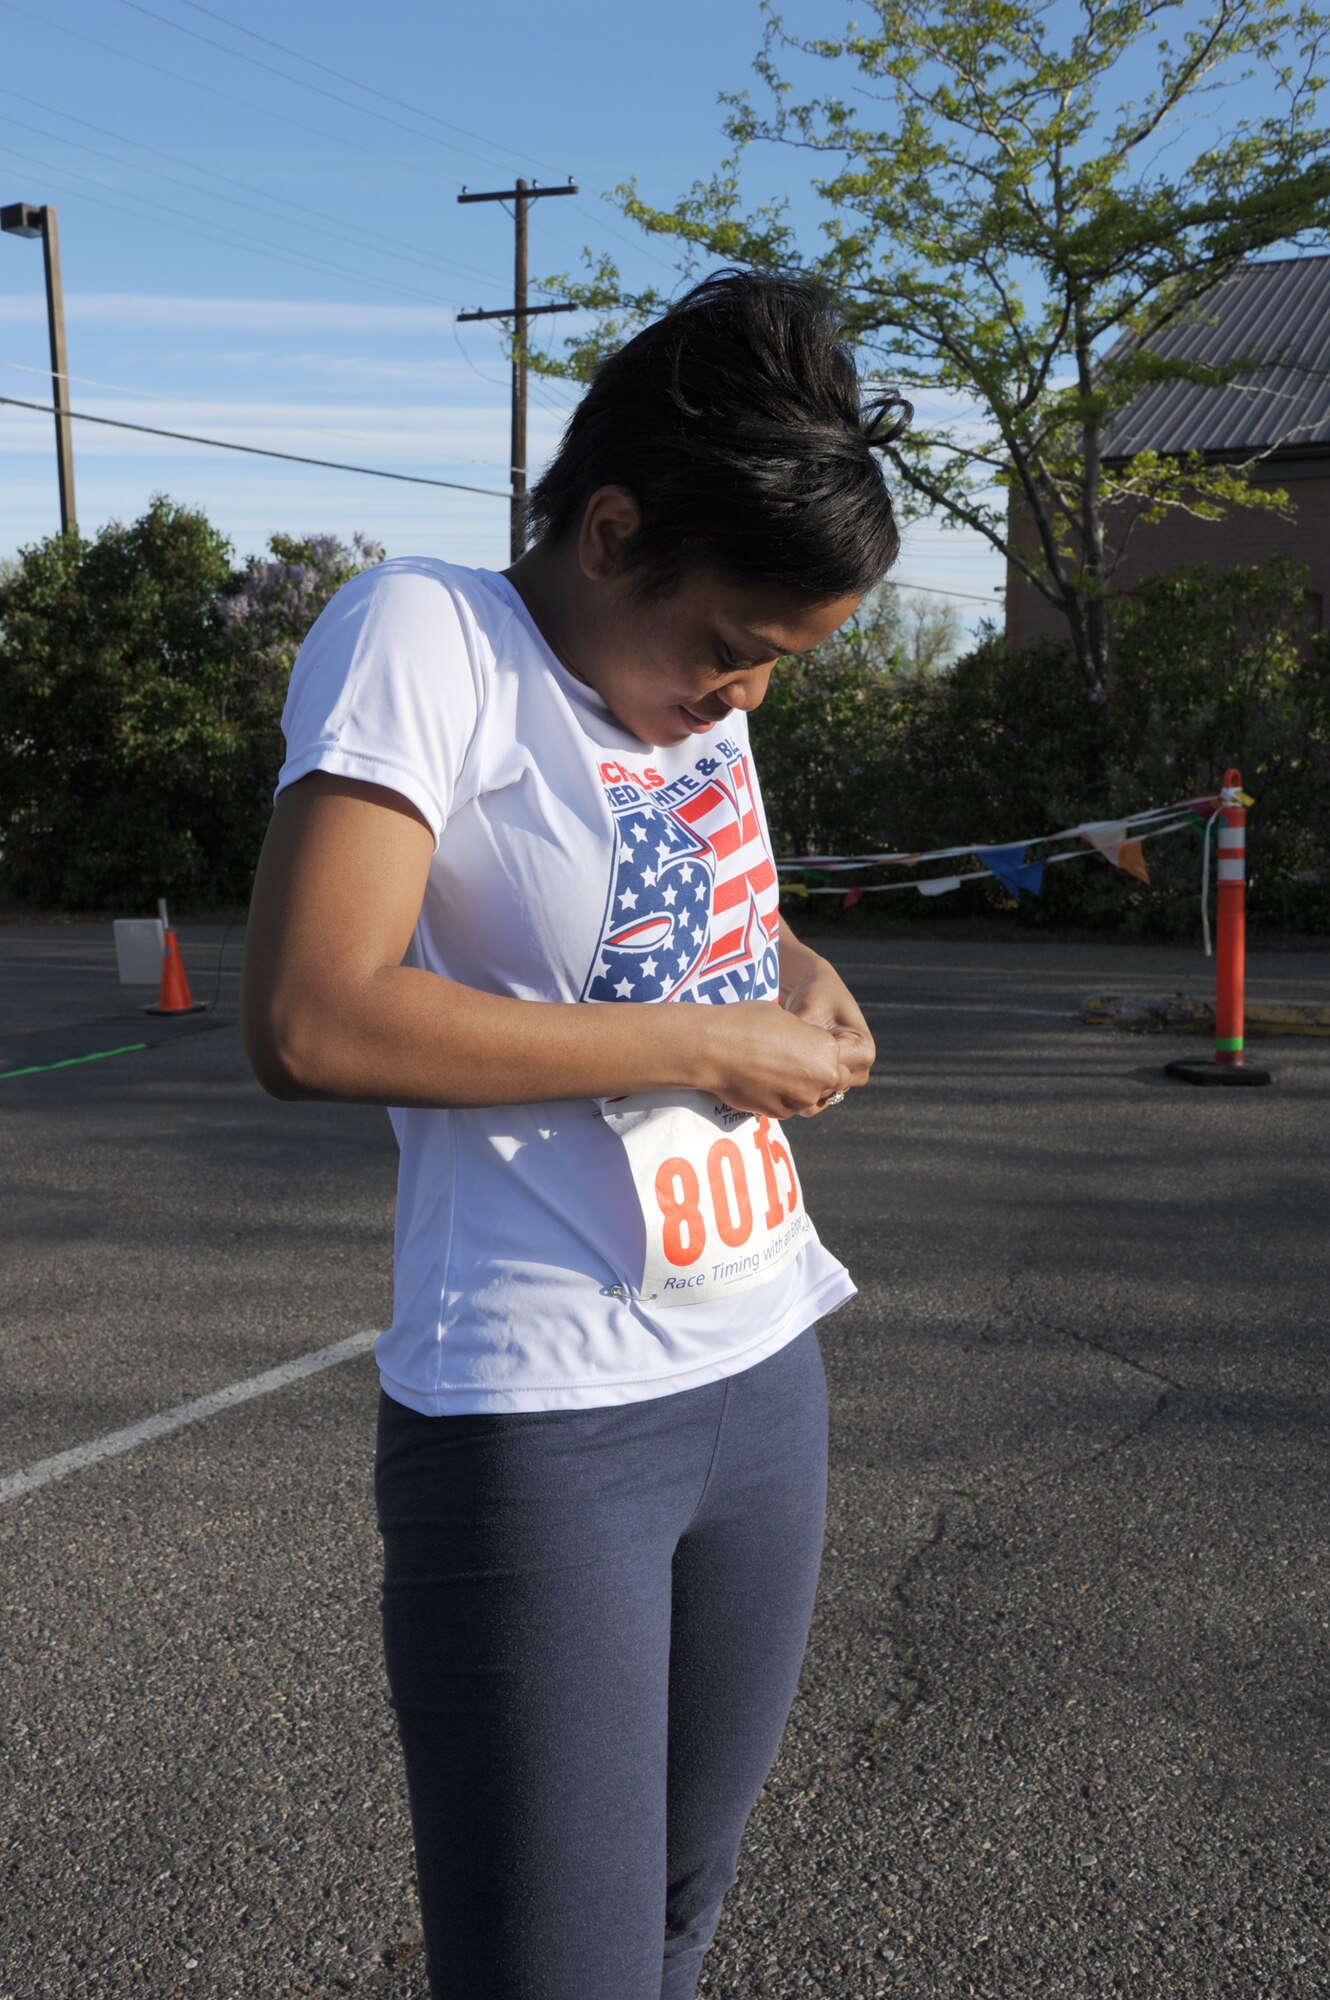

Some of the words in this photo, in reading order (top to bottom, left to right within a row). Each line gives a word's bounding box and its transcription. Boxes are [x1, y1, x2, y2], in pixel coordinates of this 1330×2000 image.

[604, 784, 641, 807] RED
[641, 775, 701, 807] HITE
[695, 758, 722, 776] &
[715, 738, 740, 759] BL
[663, 1273, 706, 1291] Race
[711, 1252, 760, 1281] Timing
[763, 1236, 783, 1261] with
